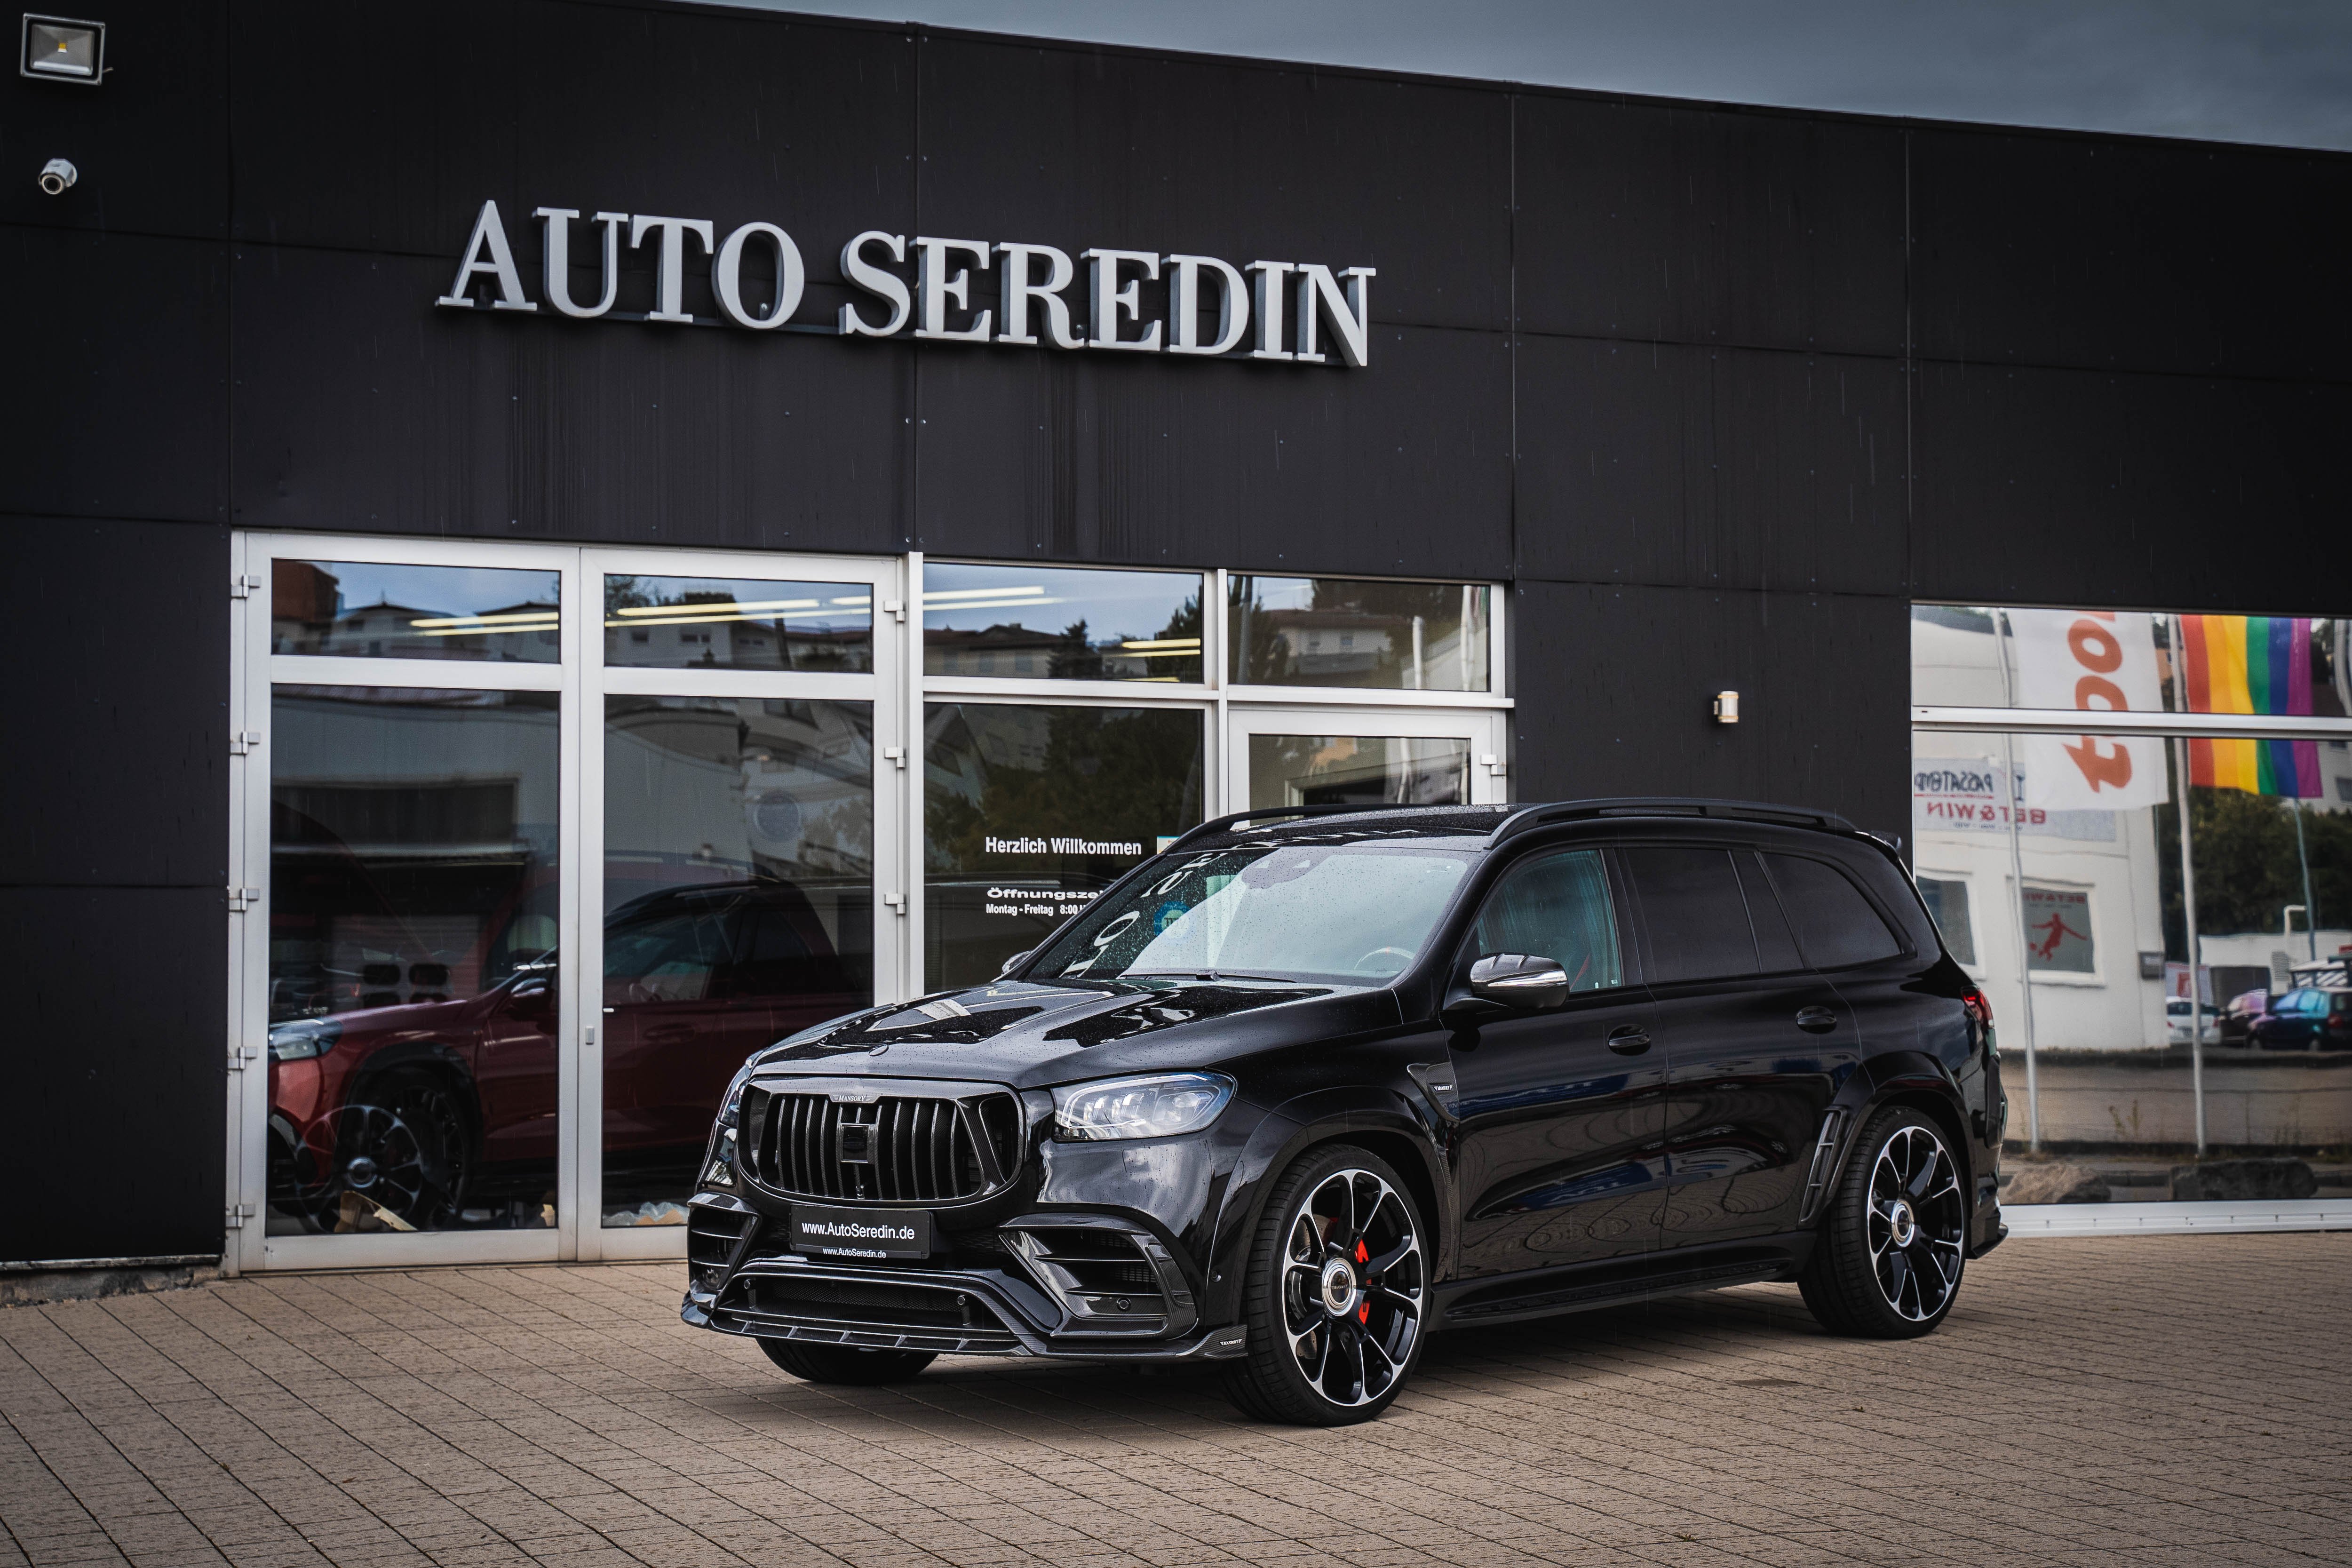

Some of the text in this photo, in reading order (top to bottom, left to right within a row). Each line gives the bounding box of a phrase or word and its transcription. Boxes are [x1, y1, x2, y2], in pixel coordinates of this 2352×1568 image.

[437, 199, 1376, 367] AUTO SEREDIN
[985, 836, 1142, 855] Herzlich Willkommen
[986, 904, 1017, 916] Montag
[1025, 904, 1054, 916] Freitag
[1060, 904, 1078, 915] 8:00
[802, 1222, 915, 1240] www.AutoSeredin.de
[822, 1247, 886, 1258] www.AutoSeredin.de
